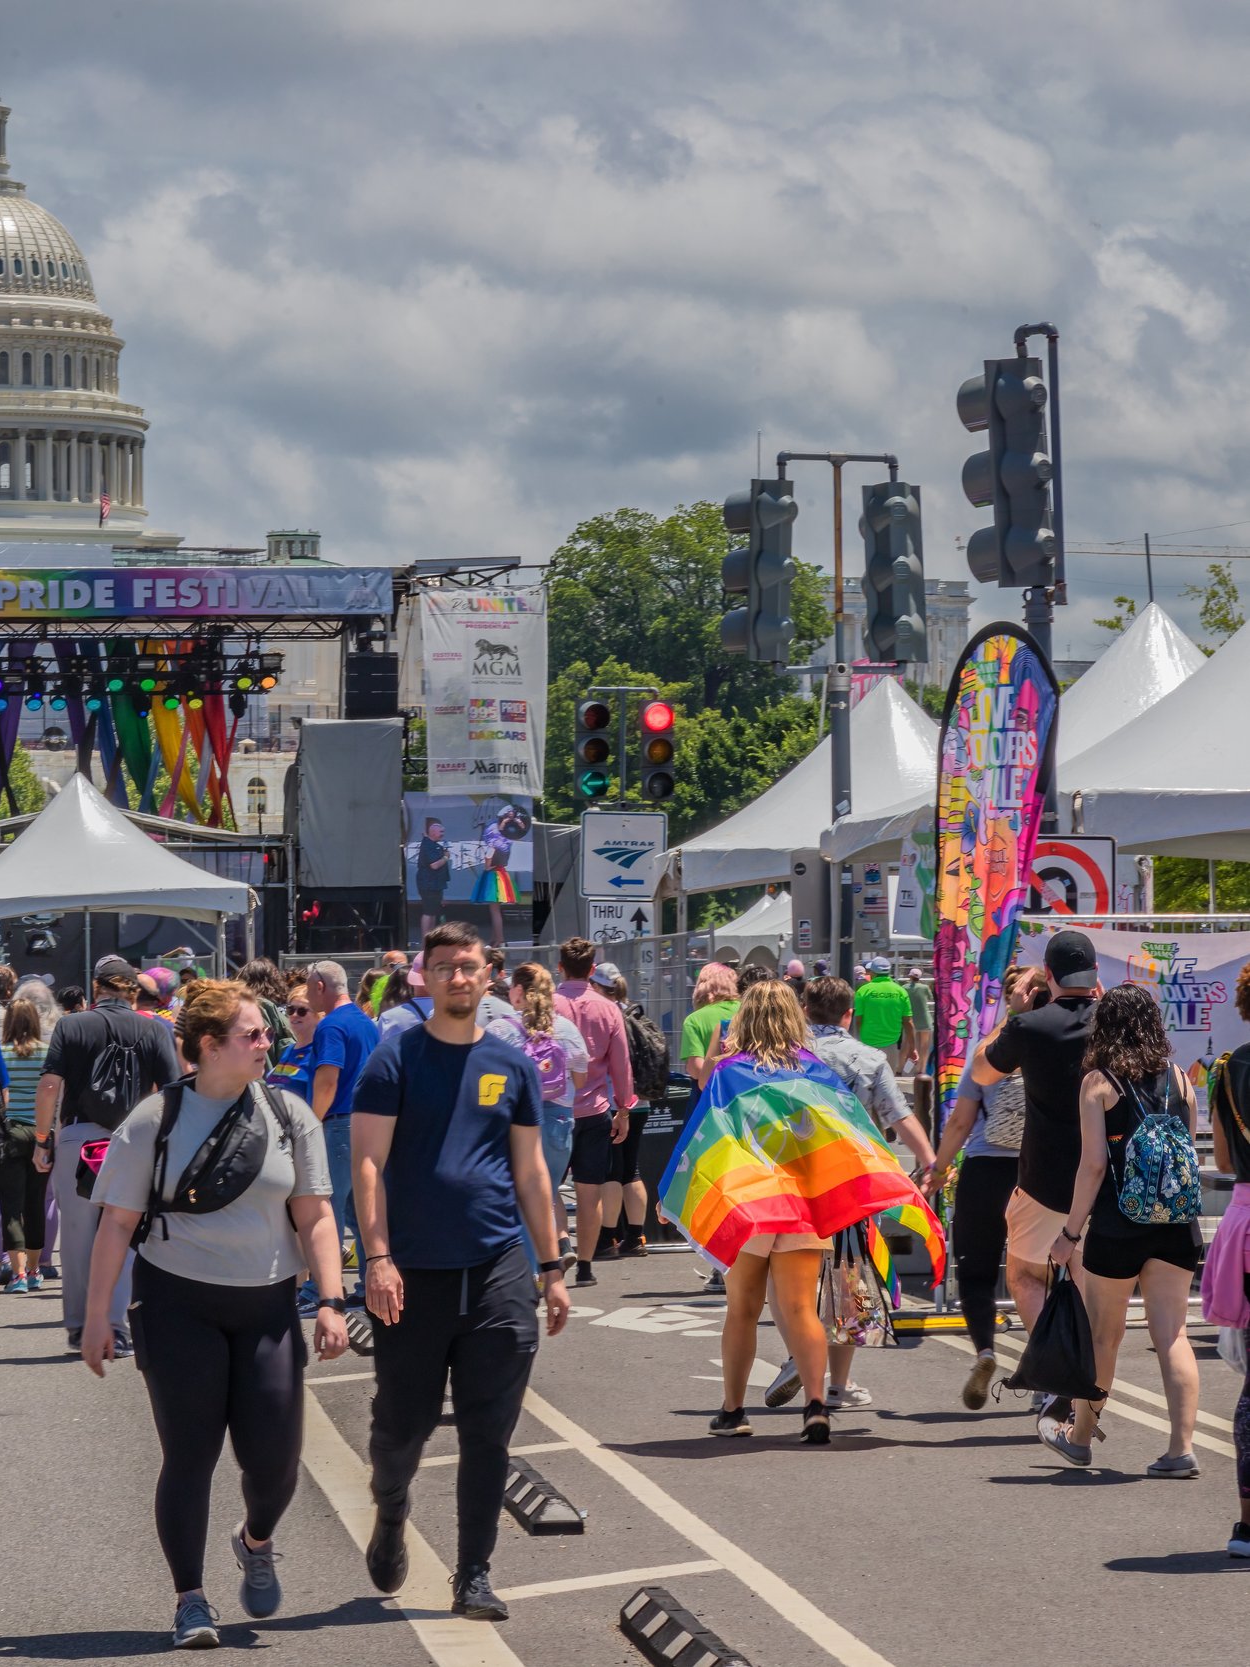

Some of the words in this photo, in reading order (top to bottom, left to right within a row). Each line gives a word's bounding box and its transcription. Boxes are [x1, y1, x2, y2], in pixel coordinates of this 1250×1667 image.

[133, 575, 319, 608] FESTIVAL
[472, 661, 522, 676] MGM
[501, 702, 526, 714] PRIDE
[469, 730, 527, 741] DARCARS
[469, 759, 528, 775] Marriott
[592, 905, 624, 919] THRU
[1127, 954, 1198, 984] LOVE
